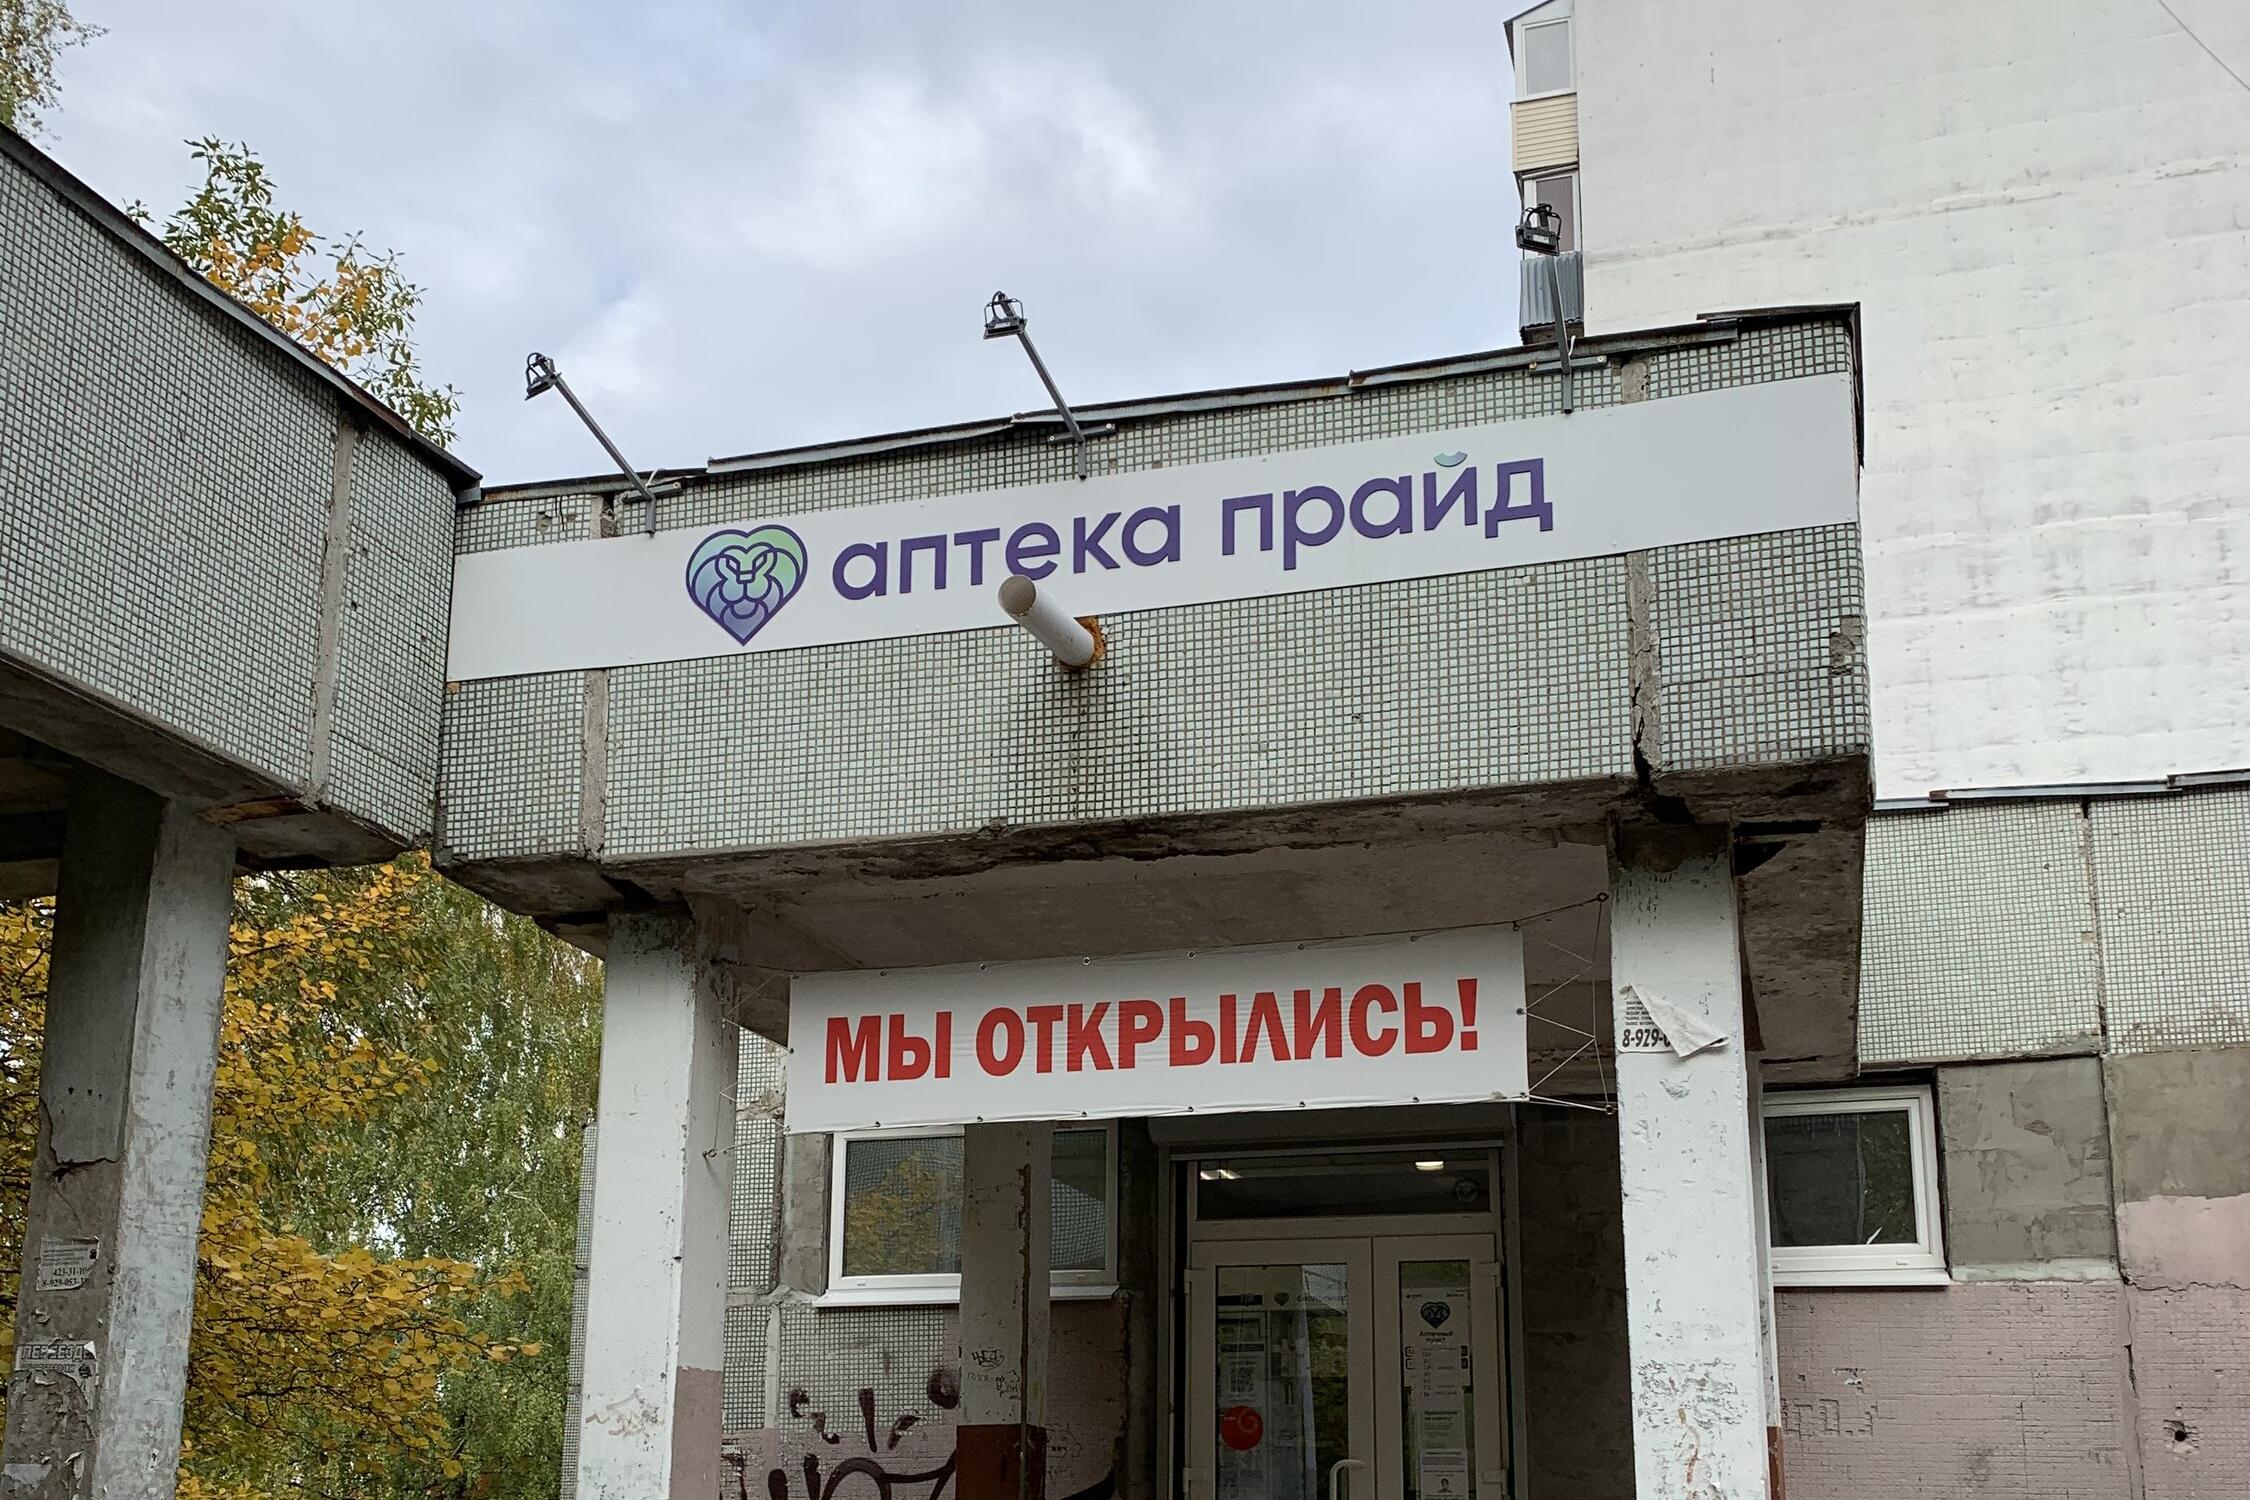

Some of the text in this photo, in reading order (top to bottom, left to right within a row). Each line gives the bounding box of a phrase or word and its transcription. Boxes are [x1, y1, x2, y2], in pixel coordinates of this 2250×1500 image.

[832, 449, 1554, 601] аптека прайд
[825, 979, 1478, 1083] МЫ ОТКРЫЛИСЬ!
